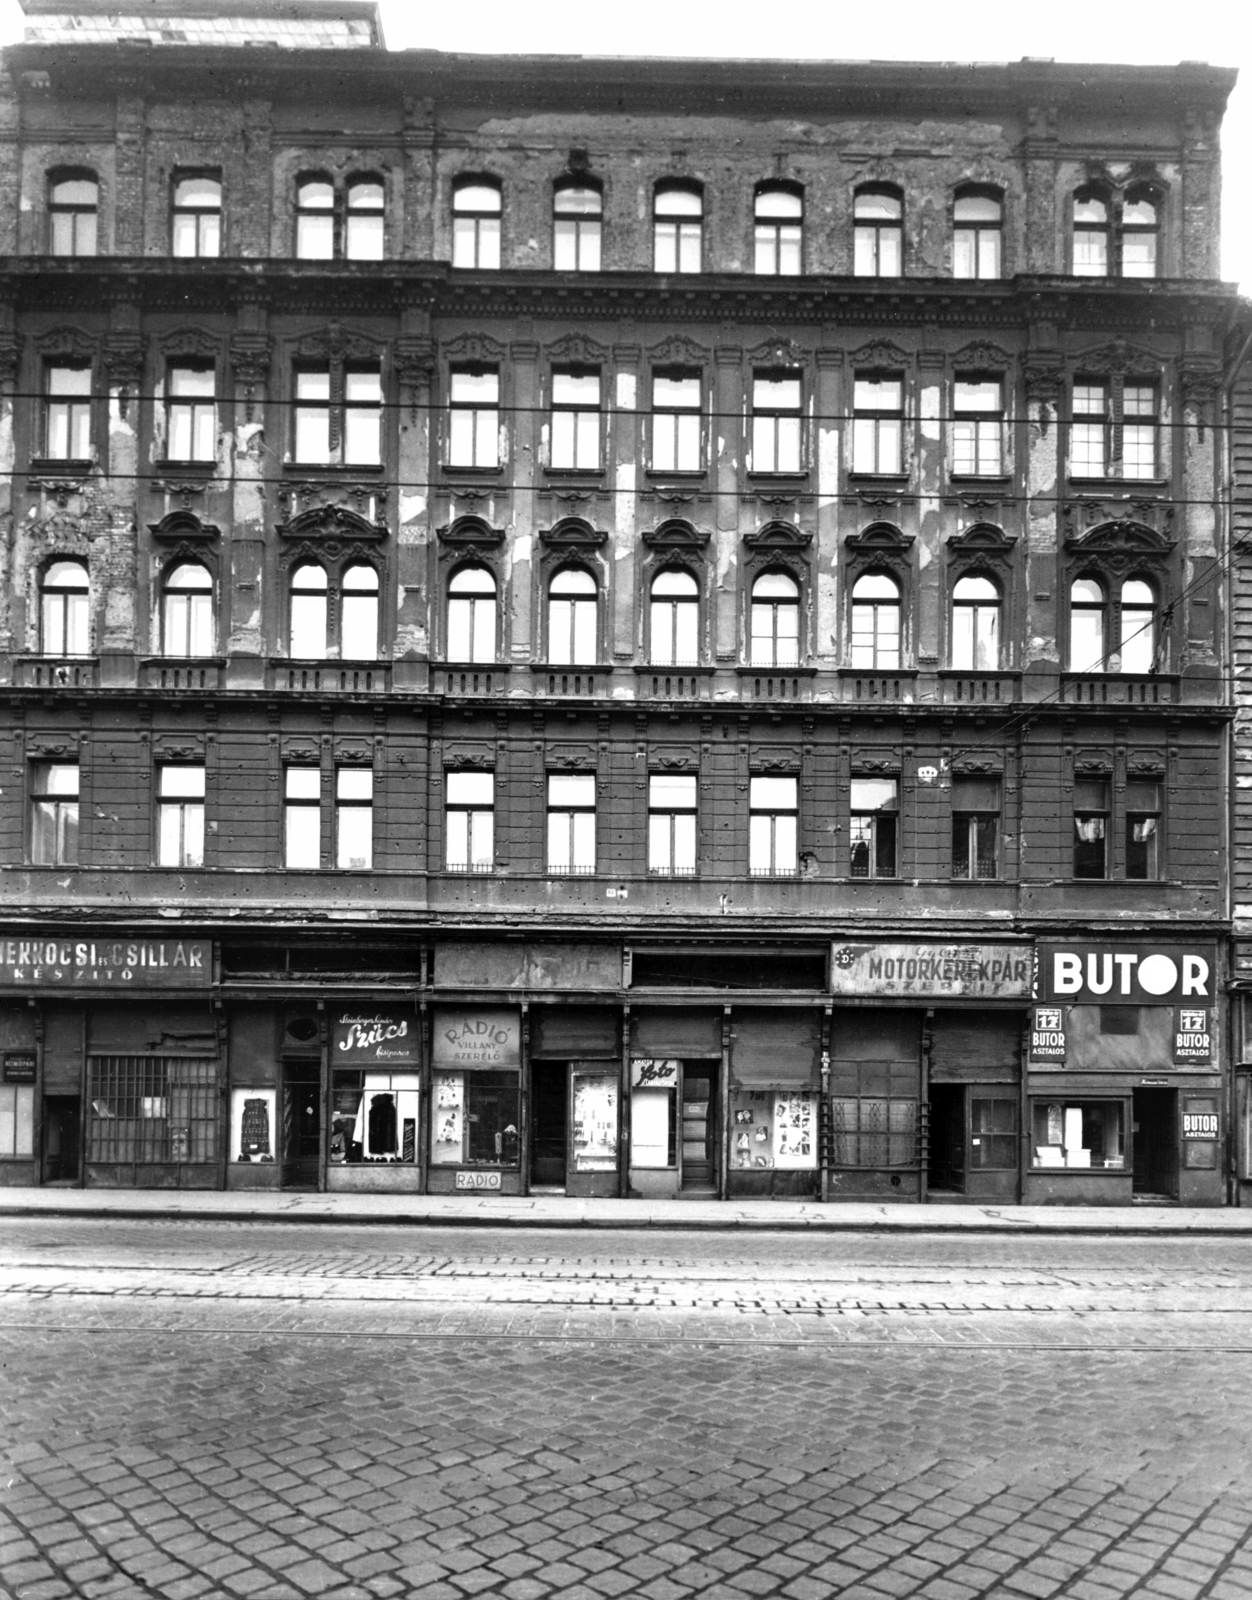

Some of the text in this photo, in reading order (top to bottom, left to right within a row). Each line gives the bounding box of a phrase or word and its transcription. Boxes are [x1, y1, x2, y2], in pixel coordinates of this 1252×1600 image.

[0, 942, 96, 966] EKKOCSI
[111, 942, 202, 967] CSILLÁR
[1054, 952, 1209, 995] BUTOR
[1038, 1015, 1059, 1028] 17
[1182, 1016, 1204, 1030] 17
[444, 1018, 512, 1044] RÁDIÓ
[458, 1041, 497, 1050] VILLANY
[1032, 1032, 1065, 1046] BUTOR
[1176, 1033, 1210, 1048] BUTOR
[1032, 1047, 1066, 1055] ASZTALOS
[1176, 1048, 1210, 1056] ASZTALOS
[1183, 1115, 1218, 1132] BUTOR
[457, 1174, 499, 1187] RADIO
